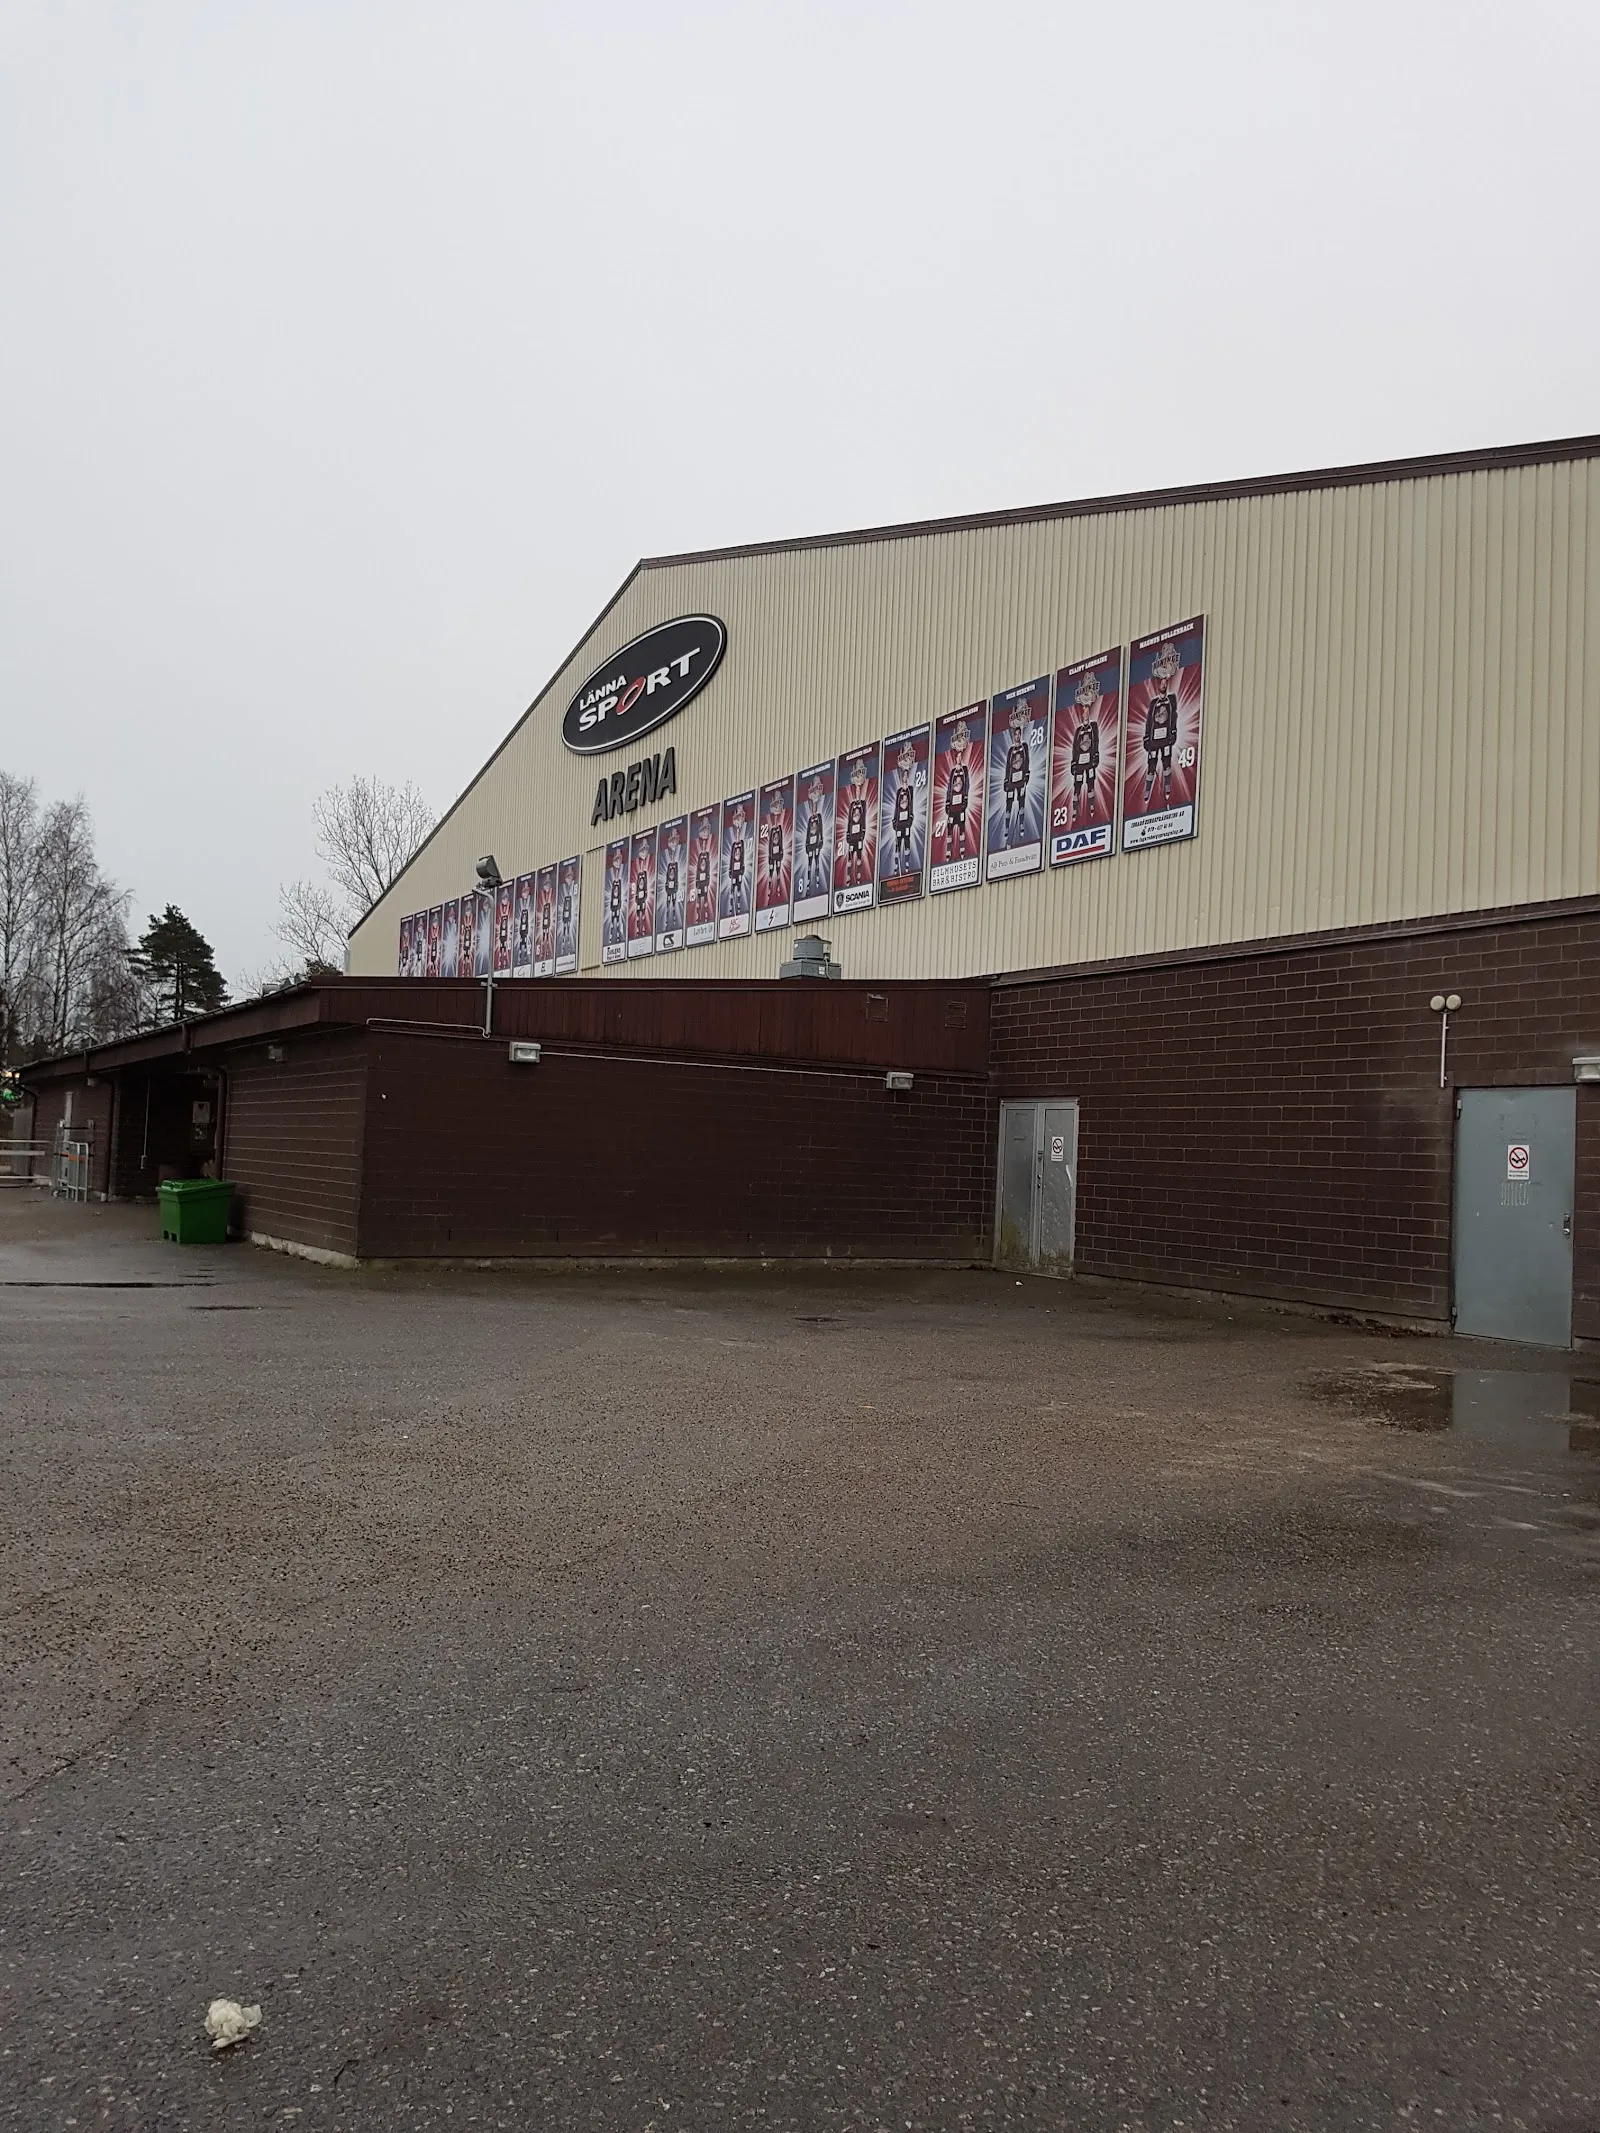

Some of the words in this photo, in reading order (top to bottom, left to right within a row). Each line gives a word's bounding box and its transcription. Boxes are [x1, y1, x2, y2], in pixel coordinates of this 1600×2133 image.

[579, 647, 701, 732] SPORT
[579, 675, 627, 711] LÄNNA
[1030, 726, 1044, 747] 28
[1178, 747, 1195, 768] 49
[590, 746, 676, 827] ARENA
[915, 769, 927, 788] 24
[1053, 806, 1068, 827] 23
[760, 824, 769, 839] 22
[935, 820, 947, 838] 27
[1056, 828, 1106, 853] DAF
[932, 860, 977, 878] FILMHUSETS
[932, 870, 976, 887] BAR&BISTRO
[798, 878, 803, 893] 8
[845, 890, 870, 903] SCANIA
